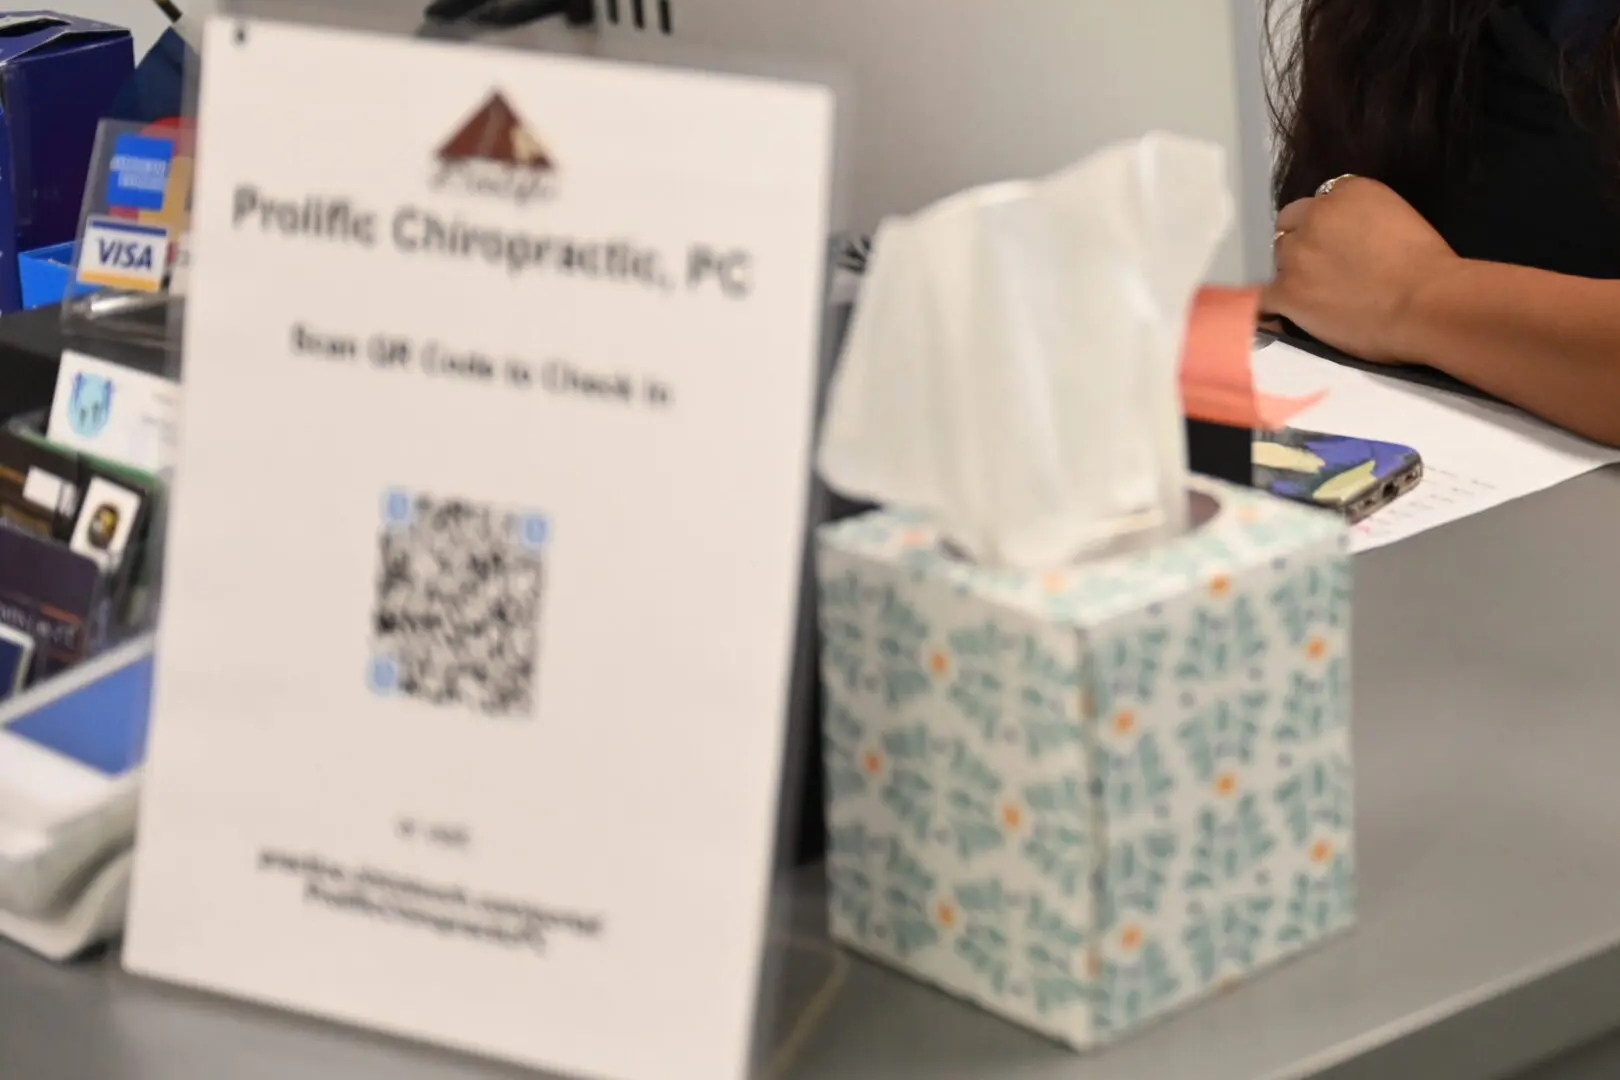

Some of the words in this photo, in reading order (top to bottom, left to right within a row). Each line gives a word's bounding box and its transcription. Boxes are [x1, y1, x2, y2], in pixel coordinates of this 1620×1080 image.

[98, 237, 154, 270] VISA
[230, 181, 379, 251] Prolific
[389, 203, 673, 292] Chiropractic,
[684, 241, 754, 301] PC
[289, 321, 361, 362] Scan
[366, 333, 417, 371] QR
[419, 340, 497, 382] Code
[501, 356, 536, 390] to
[539, 360, 637, 406] Check
